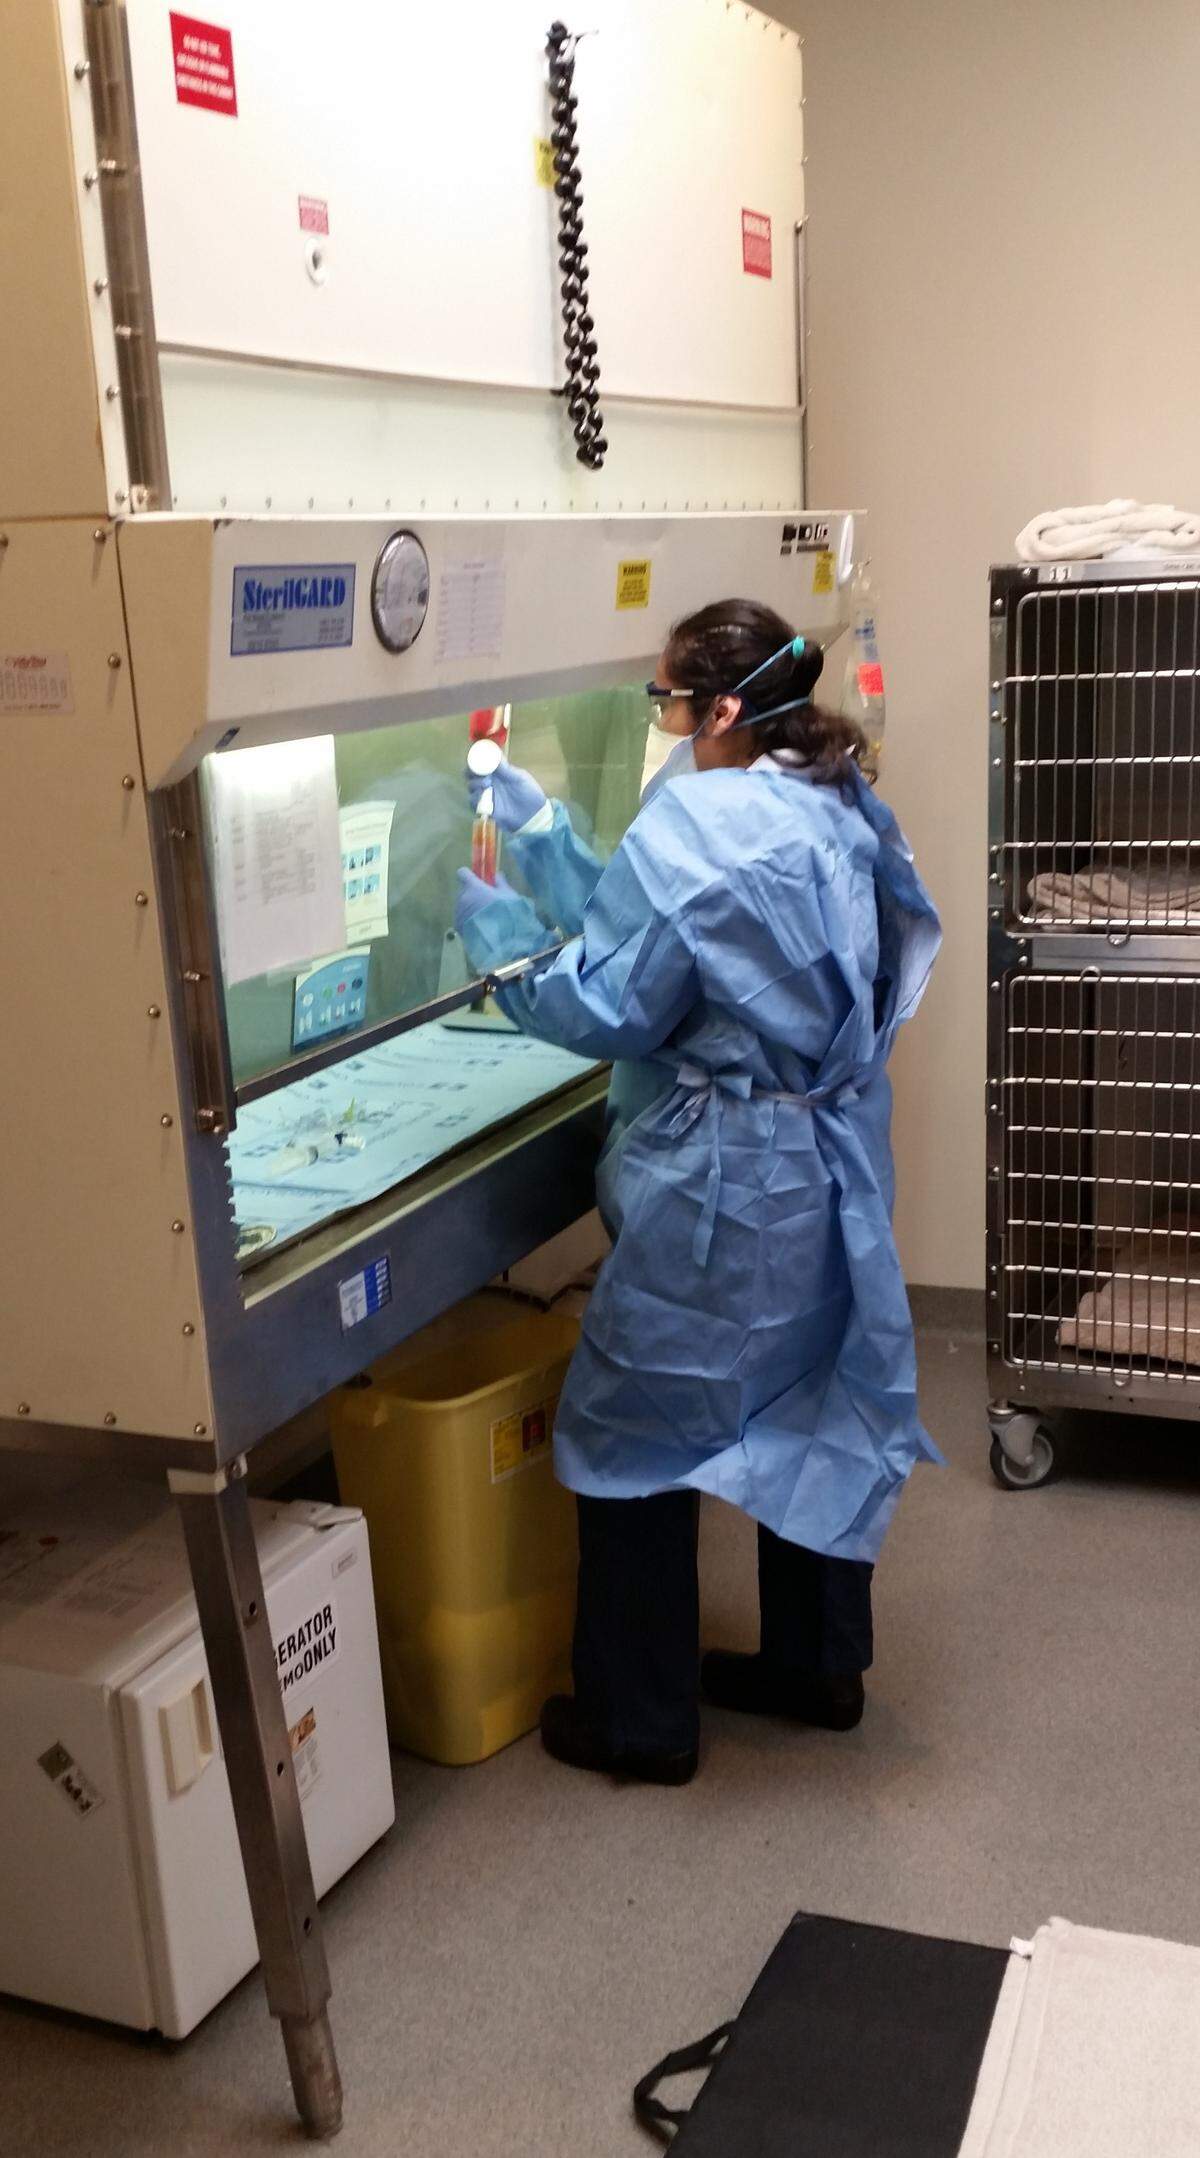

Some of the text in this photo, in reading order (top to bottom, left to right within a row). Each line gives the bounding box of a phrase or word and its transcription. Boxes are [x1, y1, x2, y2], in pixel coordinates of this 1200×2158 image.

[243, 576, 346, 613] SterilGARD
[275, 1604, 332, 1669] ERATOR
[303, 1627, 336, 1673] ONLY
[280, 1662, 304, 1691] MO
